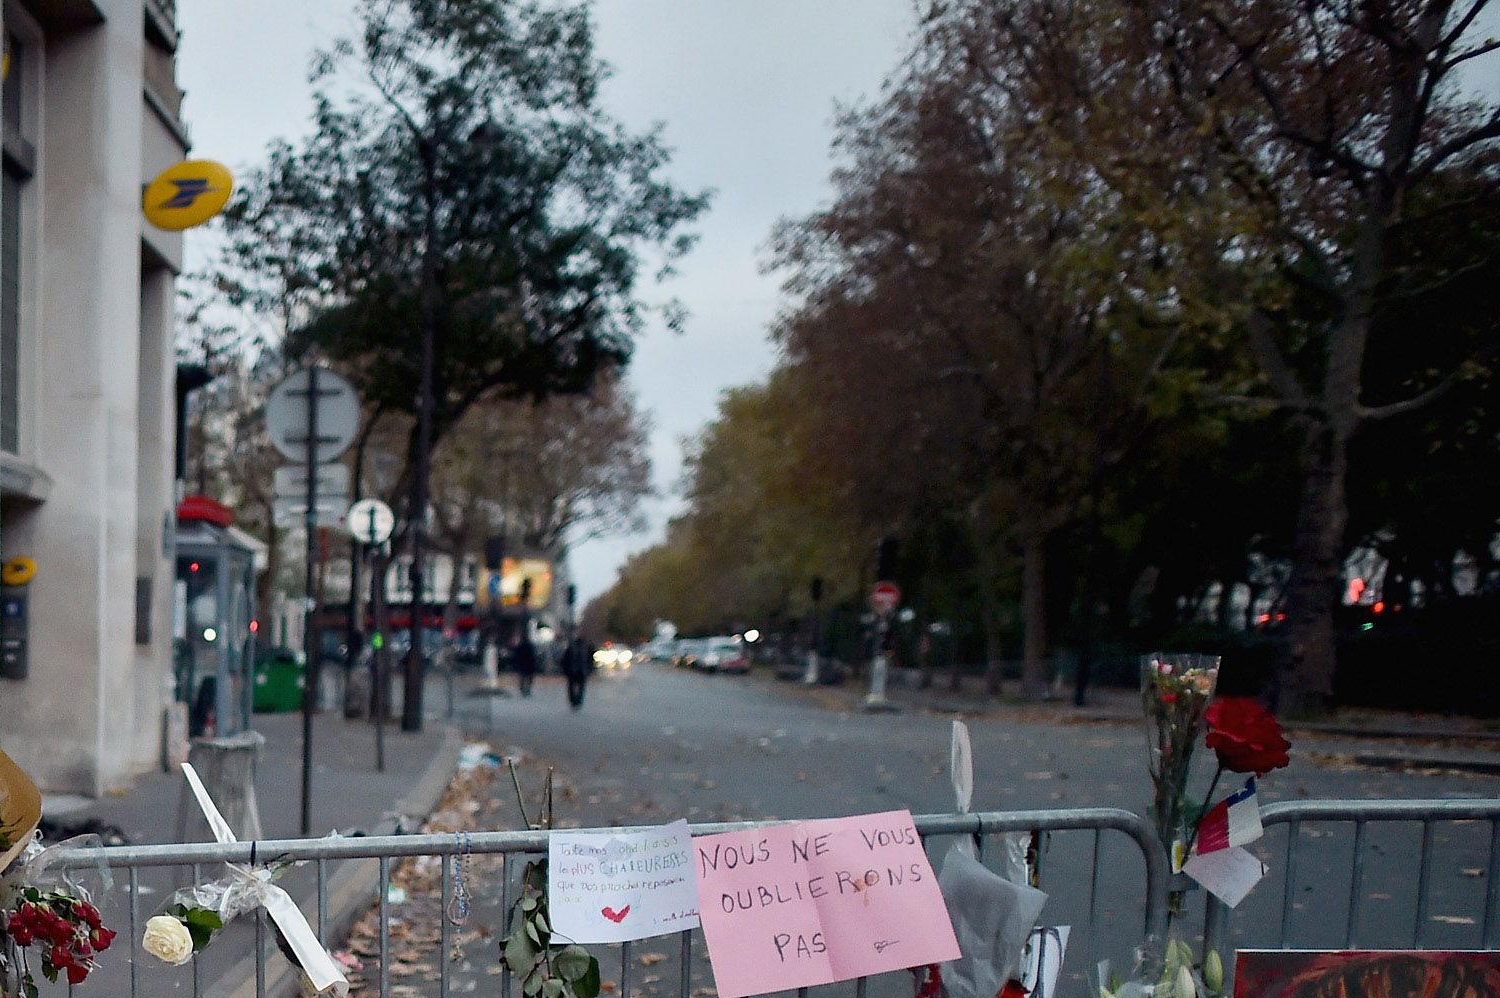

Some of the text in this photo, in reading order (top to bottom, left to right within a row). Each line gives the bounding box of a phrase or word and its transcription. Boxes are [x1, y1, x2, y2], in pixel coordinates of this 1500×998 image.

[699, 839, 770, 878] NOUS
[792, 833, 832, 863] NE
[861, 827, 916, 851] VOUS
[722, 863, 922, 914] OUBLIERONS
[774, 932, 827, 962] PAS
